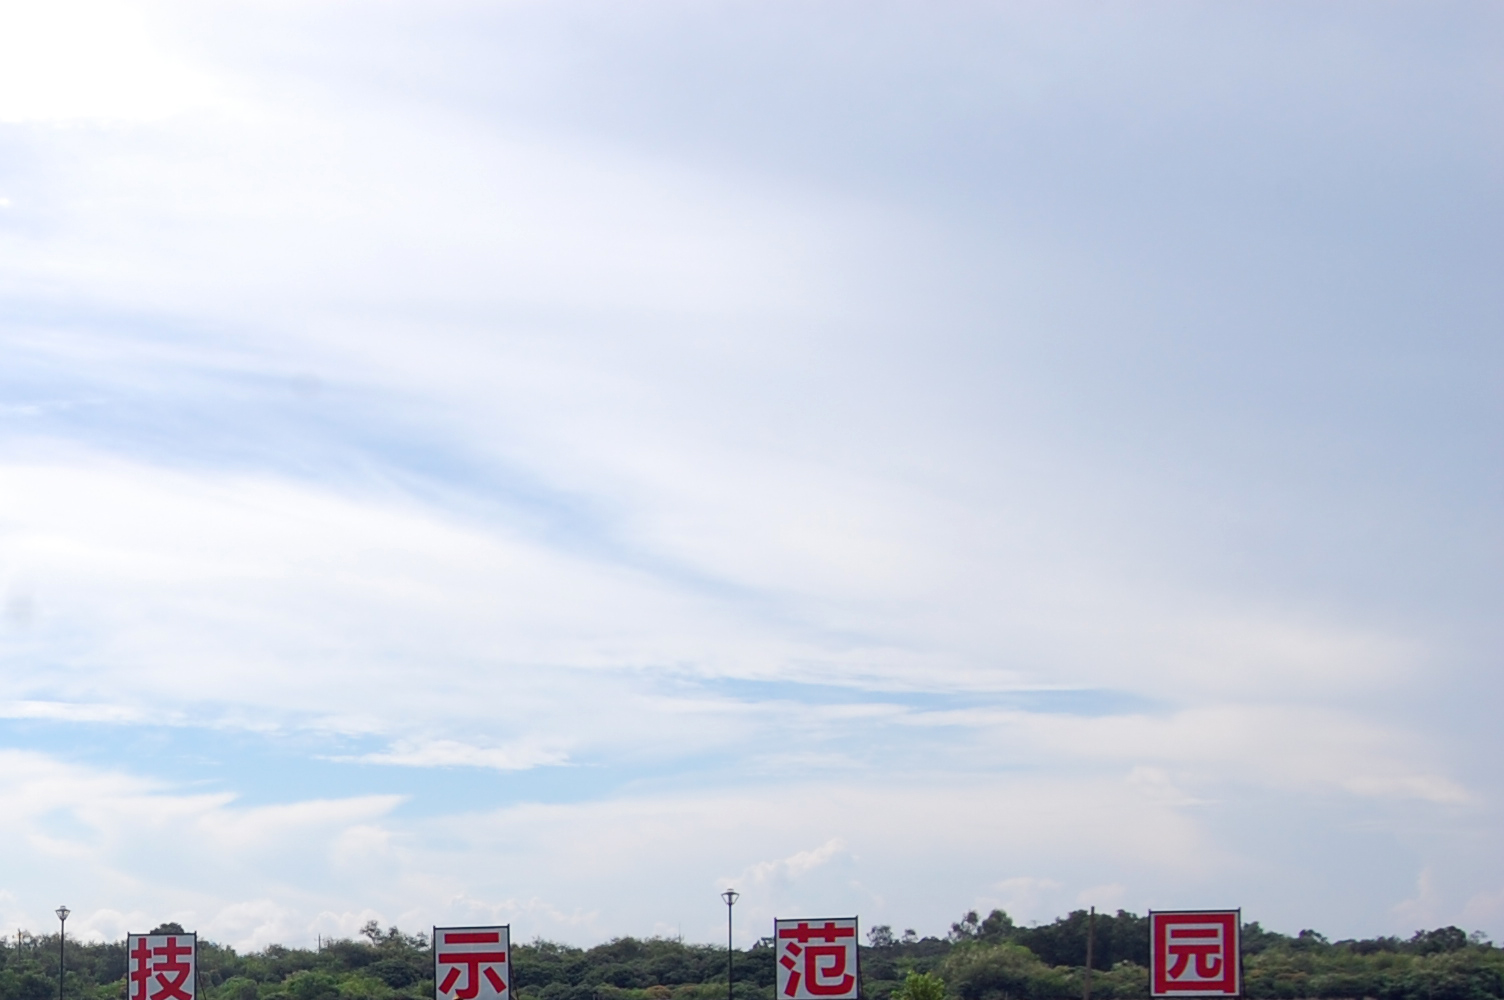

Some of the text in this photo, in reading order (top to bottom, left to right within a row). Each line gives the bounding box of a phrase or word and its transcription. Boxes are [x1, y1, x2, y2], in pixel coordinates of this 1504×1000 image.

[438, 933, 505, 1000] 示
[779, 923, 854, 996] 范
[1155, 913, 1236, 994] 园
